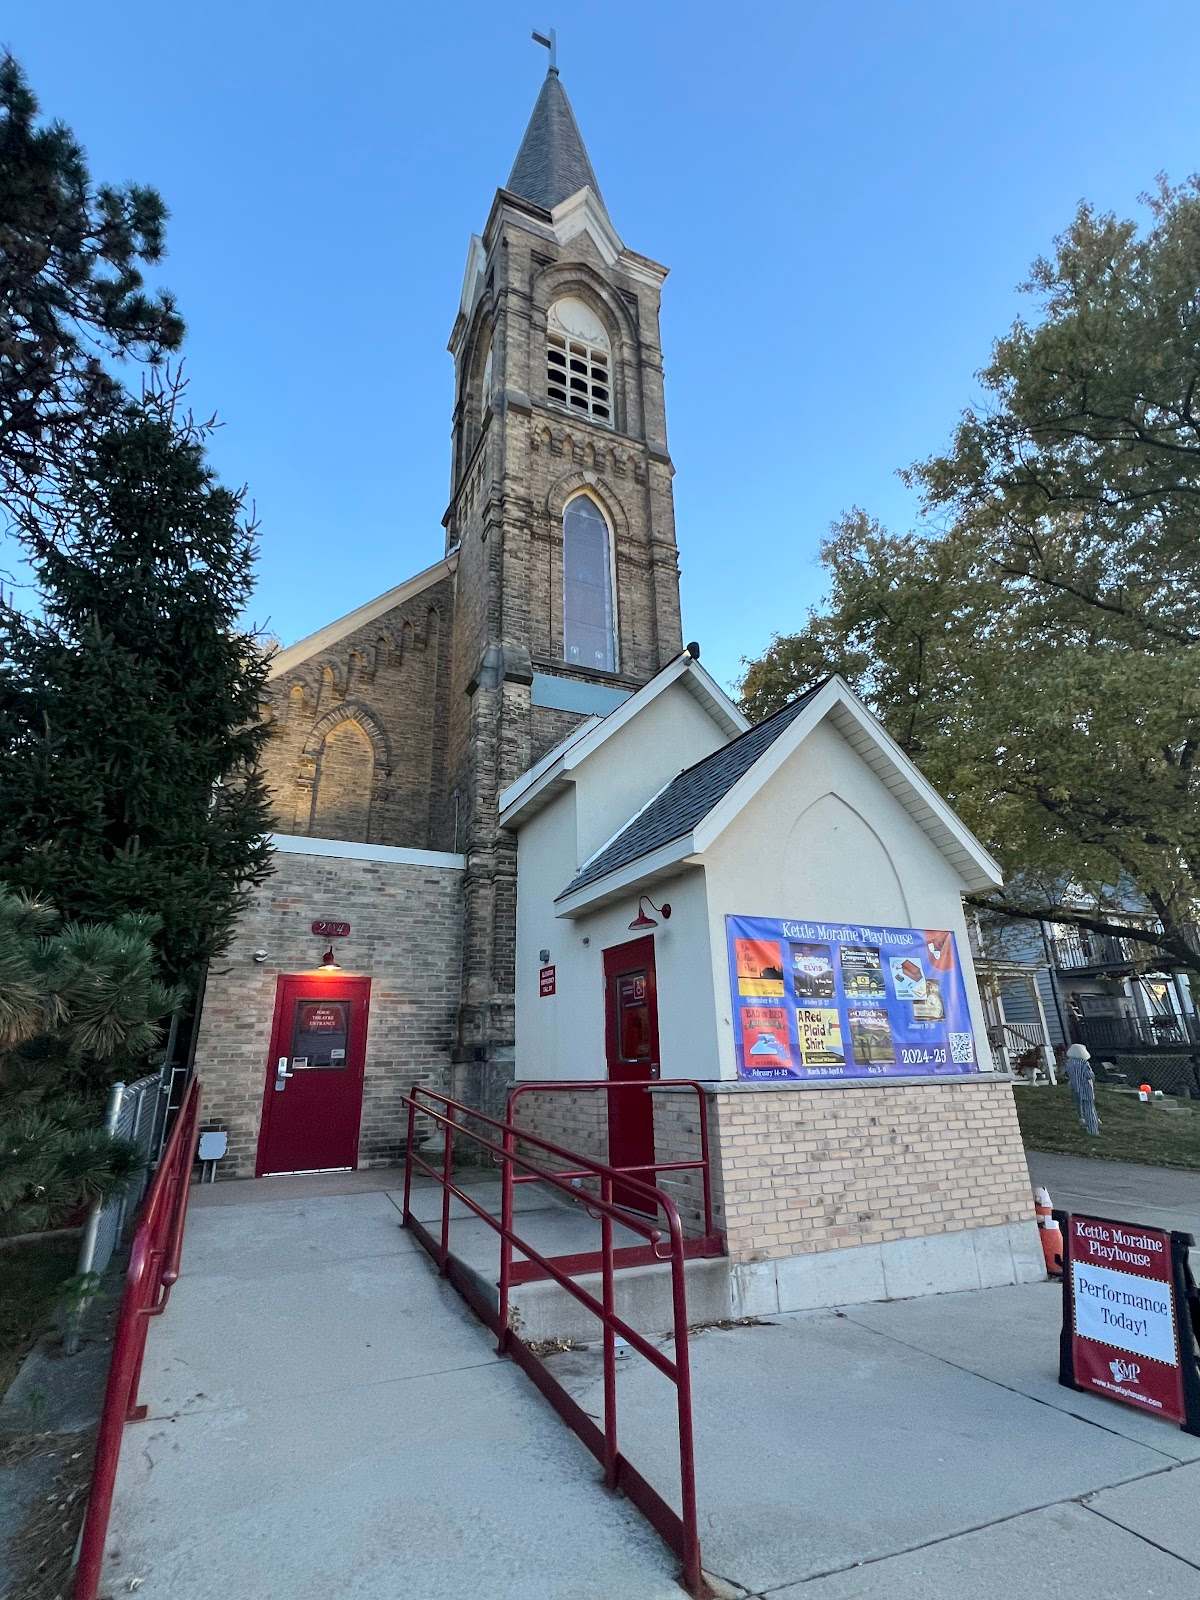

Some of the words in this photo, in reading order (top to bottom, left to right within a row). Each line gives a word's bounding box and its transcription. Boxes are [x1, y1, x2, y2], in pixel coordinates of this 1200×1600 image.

[782, 921, 816, 939] Kettle
[816, 925, 859, 941] Moraine
[860, 927, 914, 946] Playhouse
[798, 1010, 804, 1022] A
[804, 1010, 822, 1023] Red
[804, 1024, 826, 1037] Plaid
[805, 1038, 825, 1050] Shirt
[901, 1048, 947, 1064] 2024-25
[752, 1069, 773, 1077] February
[1076, 1222, 1110, 1241] Kettle
[1111, 1229, 1163, 1252] Moraine
[1088, 1240, 1151, 1267] Playhouse
[1079, 1278, 1168, 1315] Performance
[1101, 1307, 1148, 1337] Today!
[1115, 1358, 1141, 1380] KMP
[1091, 1377, 1163, 1409] www.kmplayhouse.com
